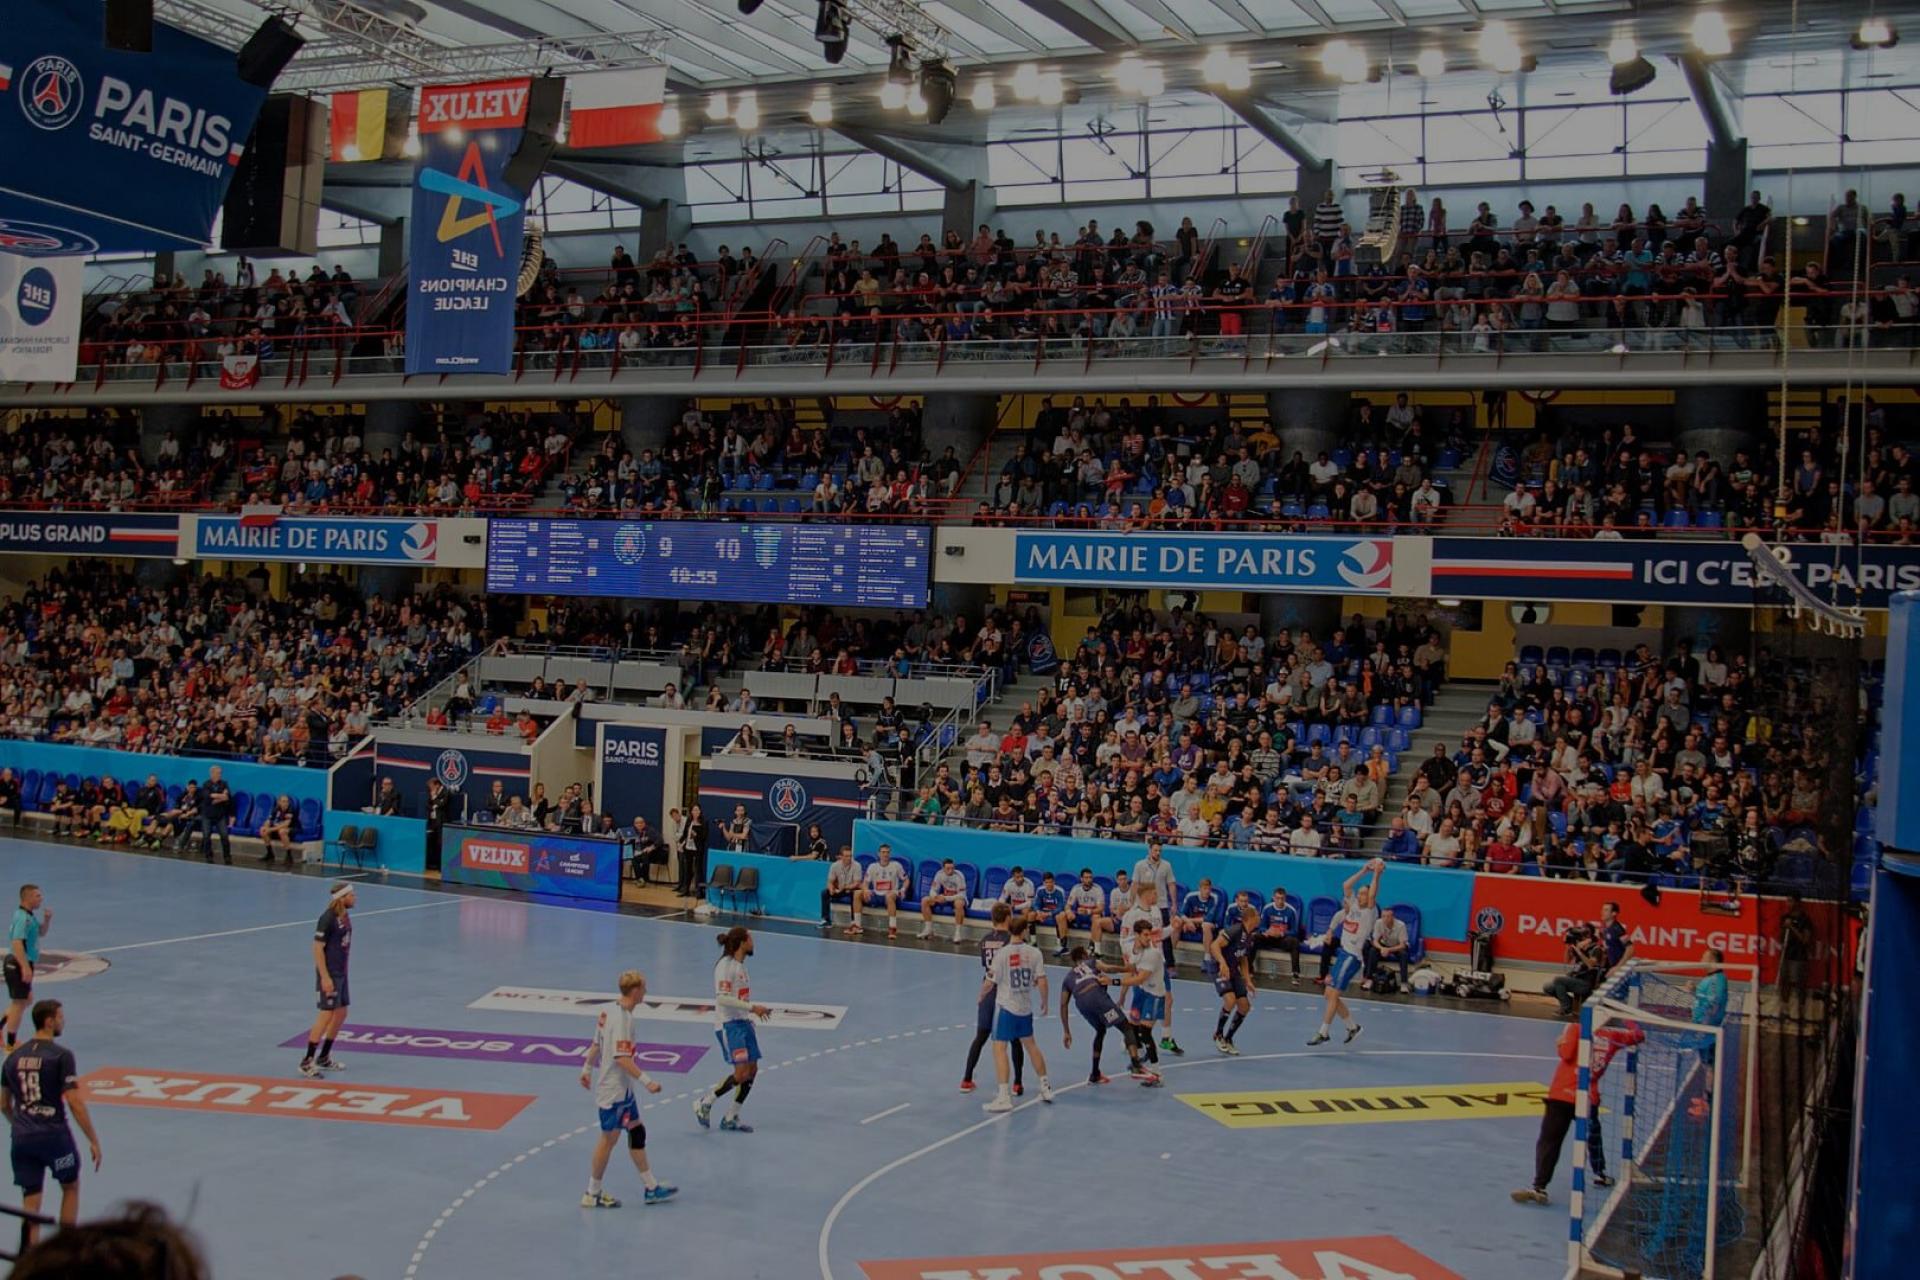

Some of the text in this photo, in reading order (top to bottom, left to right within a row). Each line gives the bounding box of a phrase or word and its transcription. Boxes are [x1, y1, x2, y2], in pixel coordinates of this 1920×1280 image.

[36, 60, 76, 84] PARIS
[94, 75, 232, 158] PARIS
[89, 122, 224, 179] SAINT-GERMAIN
[0, 523, 106, 544] PLUS GRAND
[204, 526, 390, 552] MAIRIE DE PARIS
[659, 536, 742, 562] 9 10
[1028, 543, 1317, 577] MAIRIE DE PARIS
[1643, 559, 1920, 591] ICI C'E PARIS
[605, 739, 659, 759] PARIS
[468, 844, 524, 867] VELUX
[1518, 914, 1604, 944] PAR
[1010, 968, 1031, 988] 89
[92, 1075, 472, 1121] VELUX
